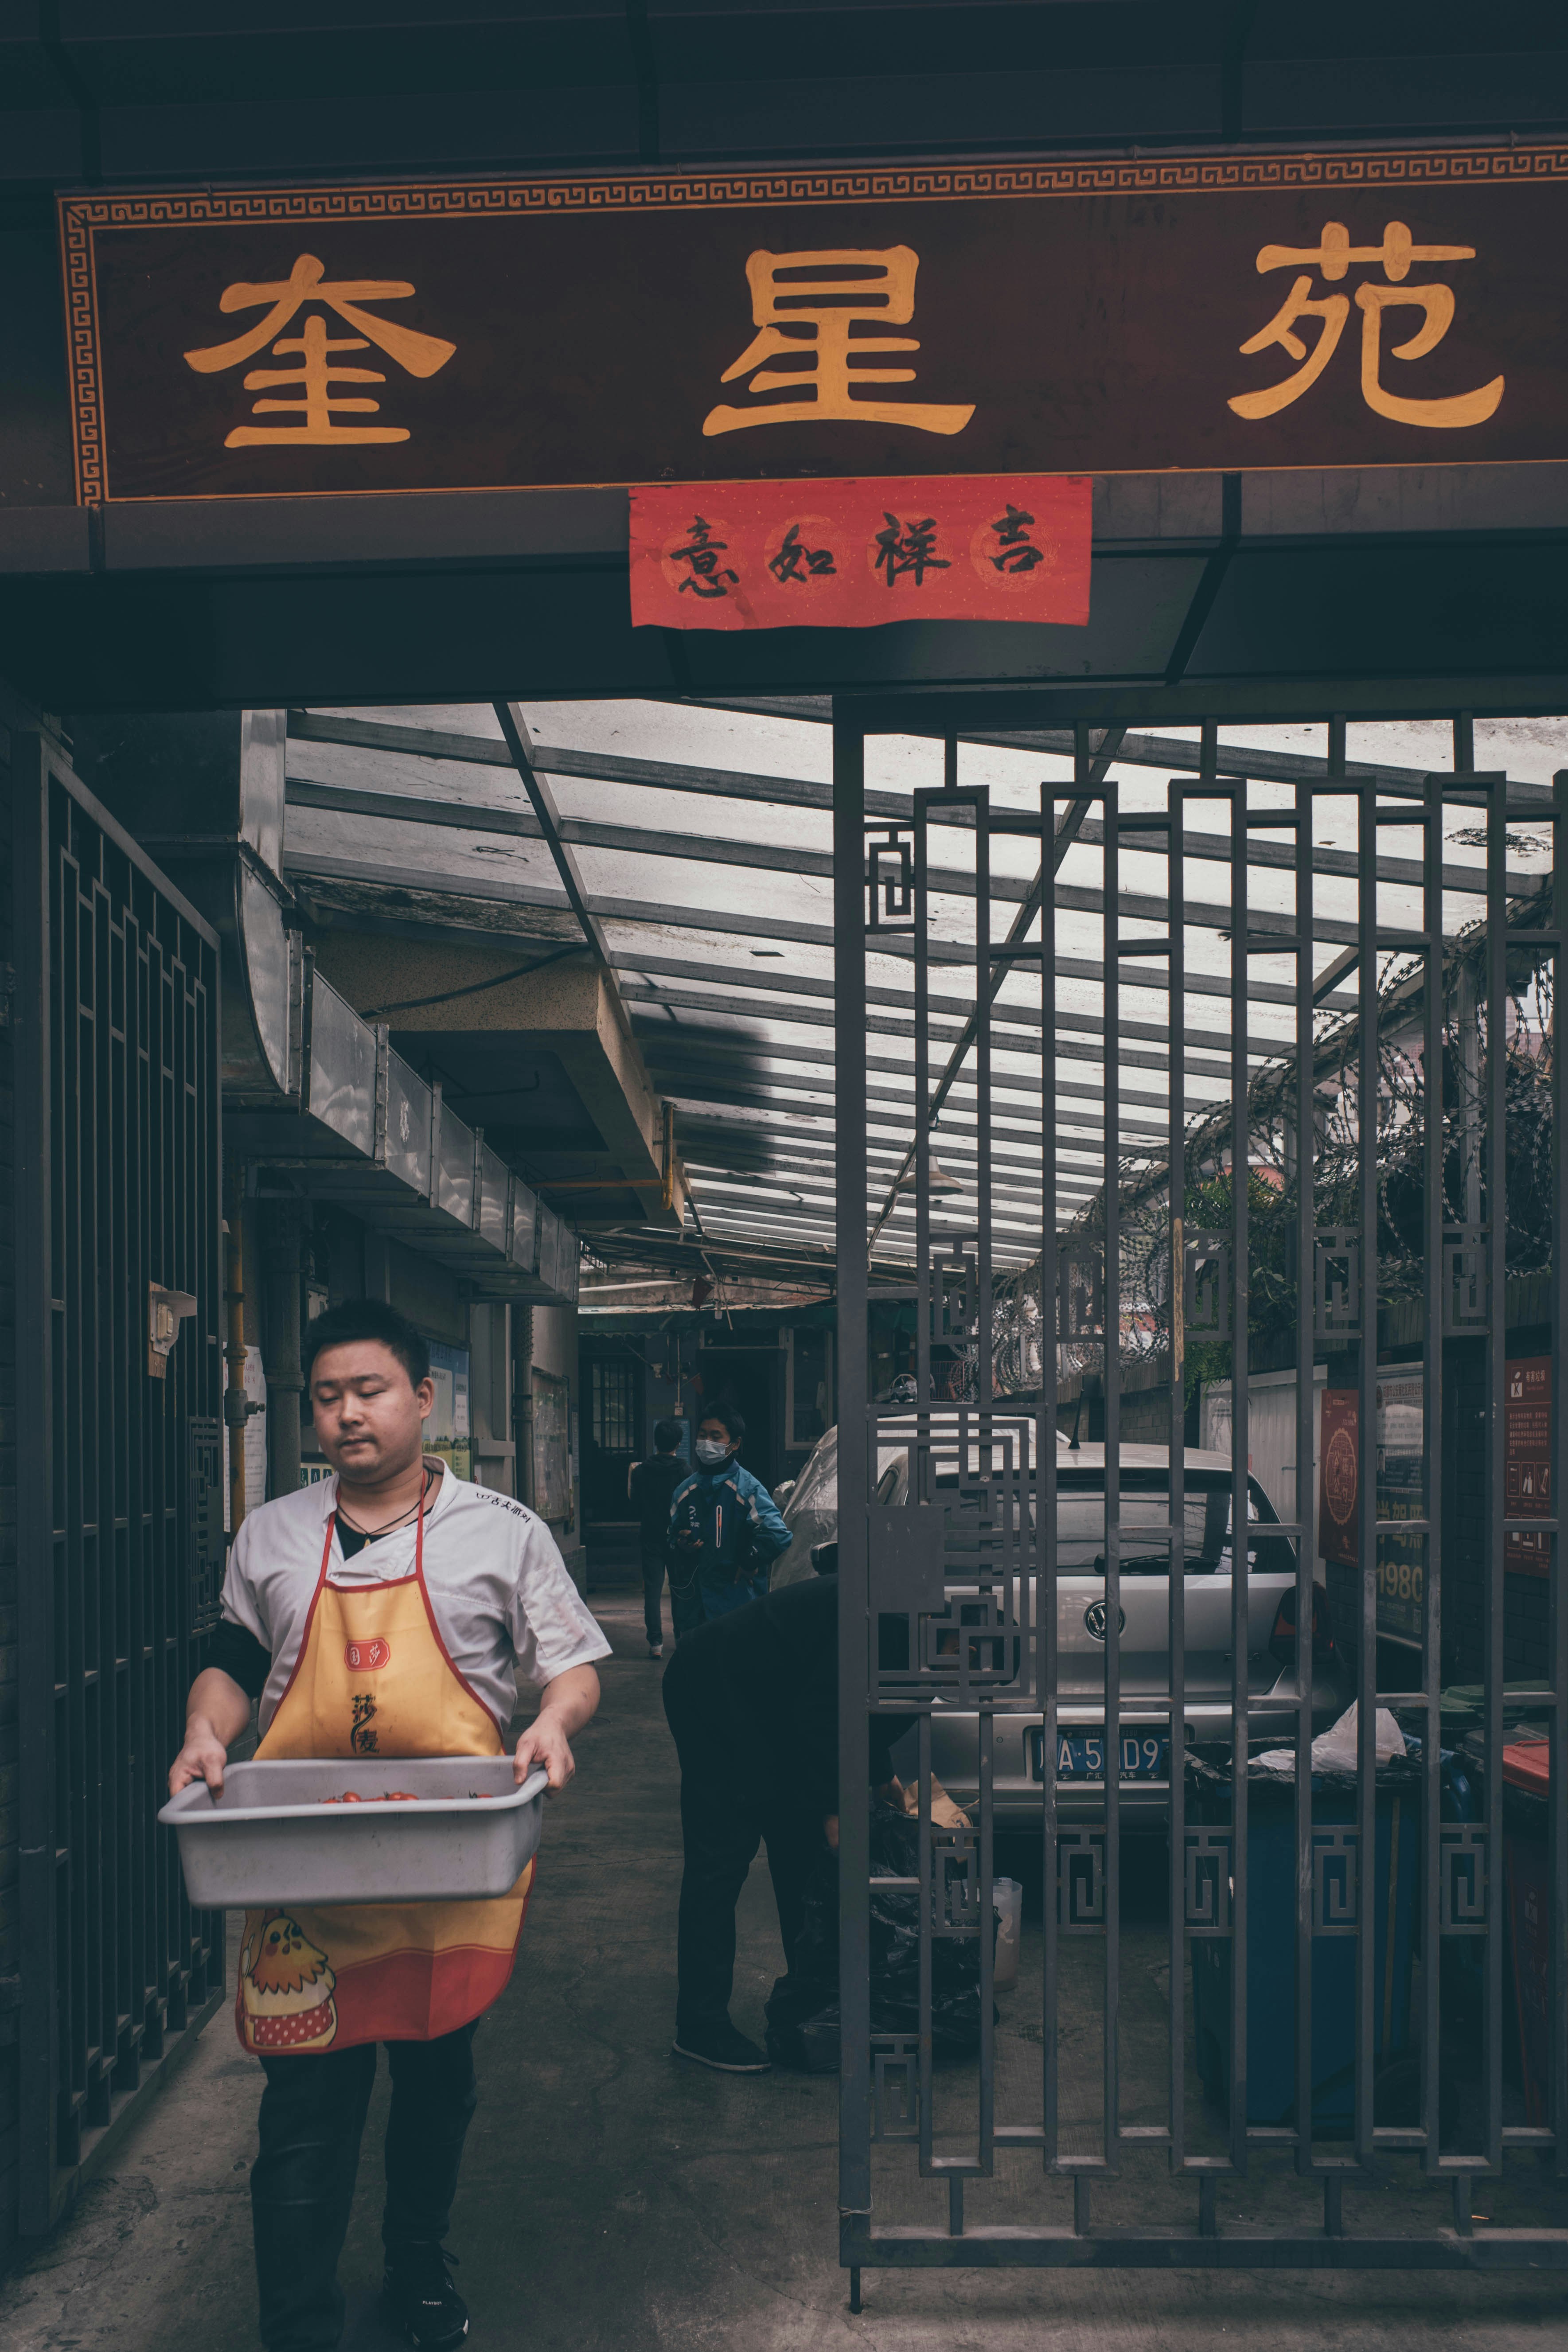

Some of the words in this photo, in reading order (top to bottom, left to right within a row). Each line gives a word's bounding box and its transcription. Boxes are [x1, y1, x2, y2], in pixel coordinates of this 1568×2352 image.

[183, 221, 1505, 449] 奎星苑
[1525, 1370, 1546, 1383] 有害垃圾
